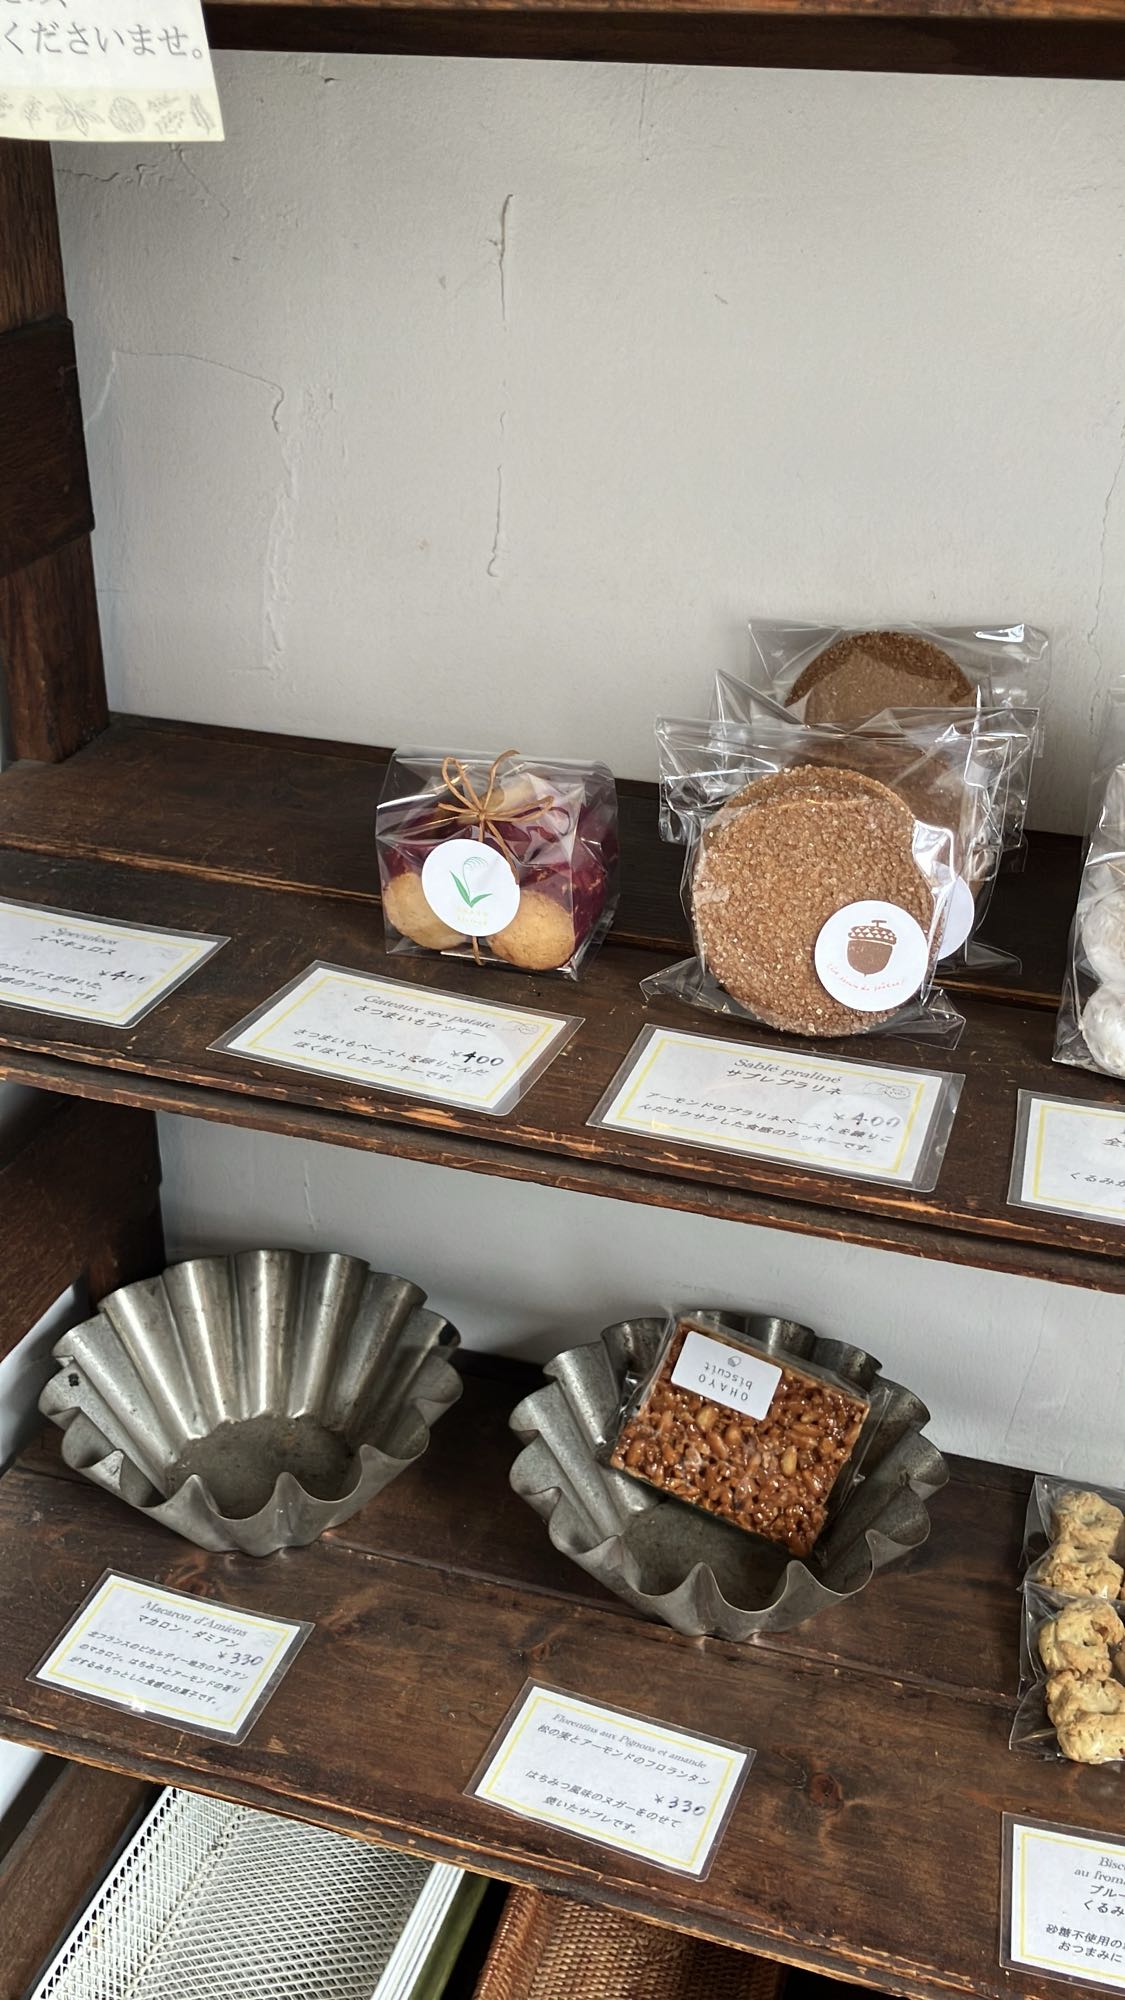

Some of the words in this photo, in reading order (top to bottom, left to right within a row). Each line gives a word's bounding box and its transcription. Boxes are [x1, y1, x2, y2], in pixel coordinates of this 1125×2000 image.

[4, 21, 203, 60] くださいませ。
[31, 935, 117, 956] スペキュロス
[353, 1005, 486, 1038] さつまいもクッキー
[452, 1050, 505, 1067] ¥400
[733, 1058, 780, 1073] Sablé
[779, 1069, 843, 1084] praliné
[698, 1373, 749, 1402] OHAYO
[704, 1361, 753, 1391] biscuit
[140, 1600, 192, 1622] Macaron
[138, 1614, 240, 1648] マカロン・ダミアン
[217, 1646, 264, 1667] ¥330
[537, 1723, 711, 1785] 松の実とアーモンドのフロランタン
[551, 1713, 599, 1734] Florentins
[598, 1729, 617, 1742] aux
[617, 1735, 656, 1753] Pignons
[667, 1753, 707, 1769] amande
[524, 1770, 682, 1829] はちみつ風味のヌガーをのせて
[1074, 1868, 1090, 1878] au
[1093, 1870, 1125, 1886] from
[1099, 1856, 1125, 1872] Bisc
[1084, 1899, 1125, 1917] くるみ
[1045, 1923, 1125, 1950] 砂糖不使用の
[1058, 1940, 1123, 1963] おつまみに
